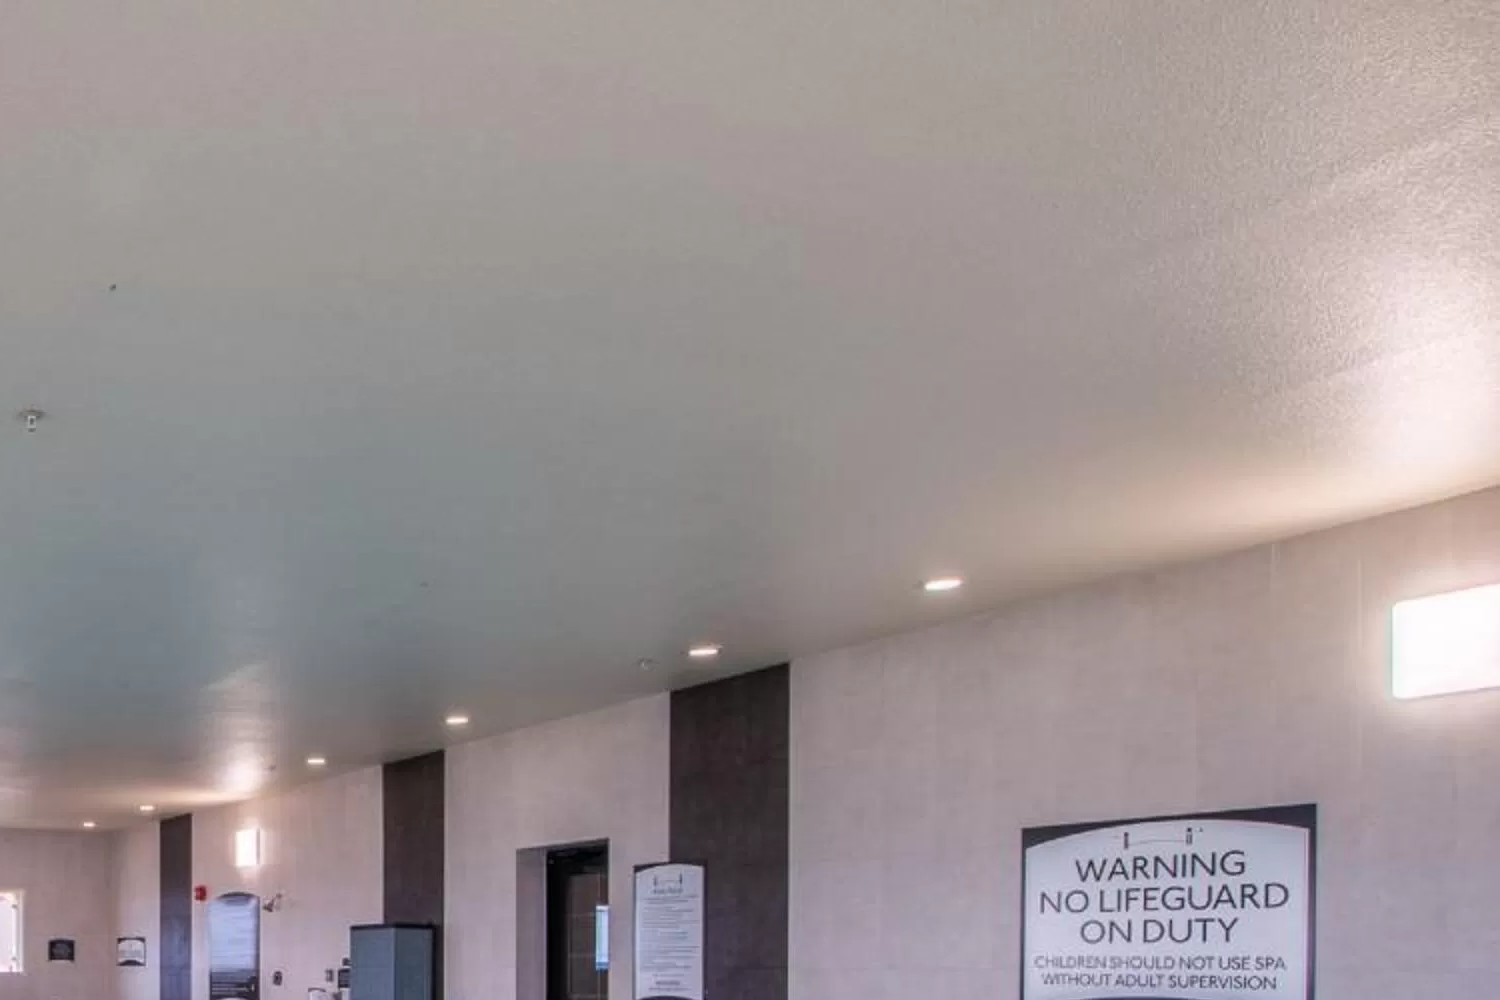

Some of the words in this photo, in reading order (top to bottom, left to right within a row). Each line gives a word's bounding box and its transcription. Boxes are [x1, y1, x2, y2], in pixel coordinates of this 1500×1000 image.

[1075, 850, 1246, 882] WARNING
[1040, 889, 1089, 914] NO
[1100, 883, 1289, 912] LIFEGUARD
[1080, 919, 1132, 944] ON
[1142, 917, 1238, 944] DUTY
[1033, 955, 1107, 969] CHILDREN
[1109, 955, 1175, 970] SHOULD
[1179, 955, 1215, 970] NOT
[1218, 955, 1251, 971] USE
[1254, 955, 1288, 971] SPA
[1041, 972, 1113, 987] WITHOUT
[1115, 973, 1165, 988] ADULT
[1167, 974, 1277, 990] SUPERVISION
